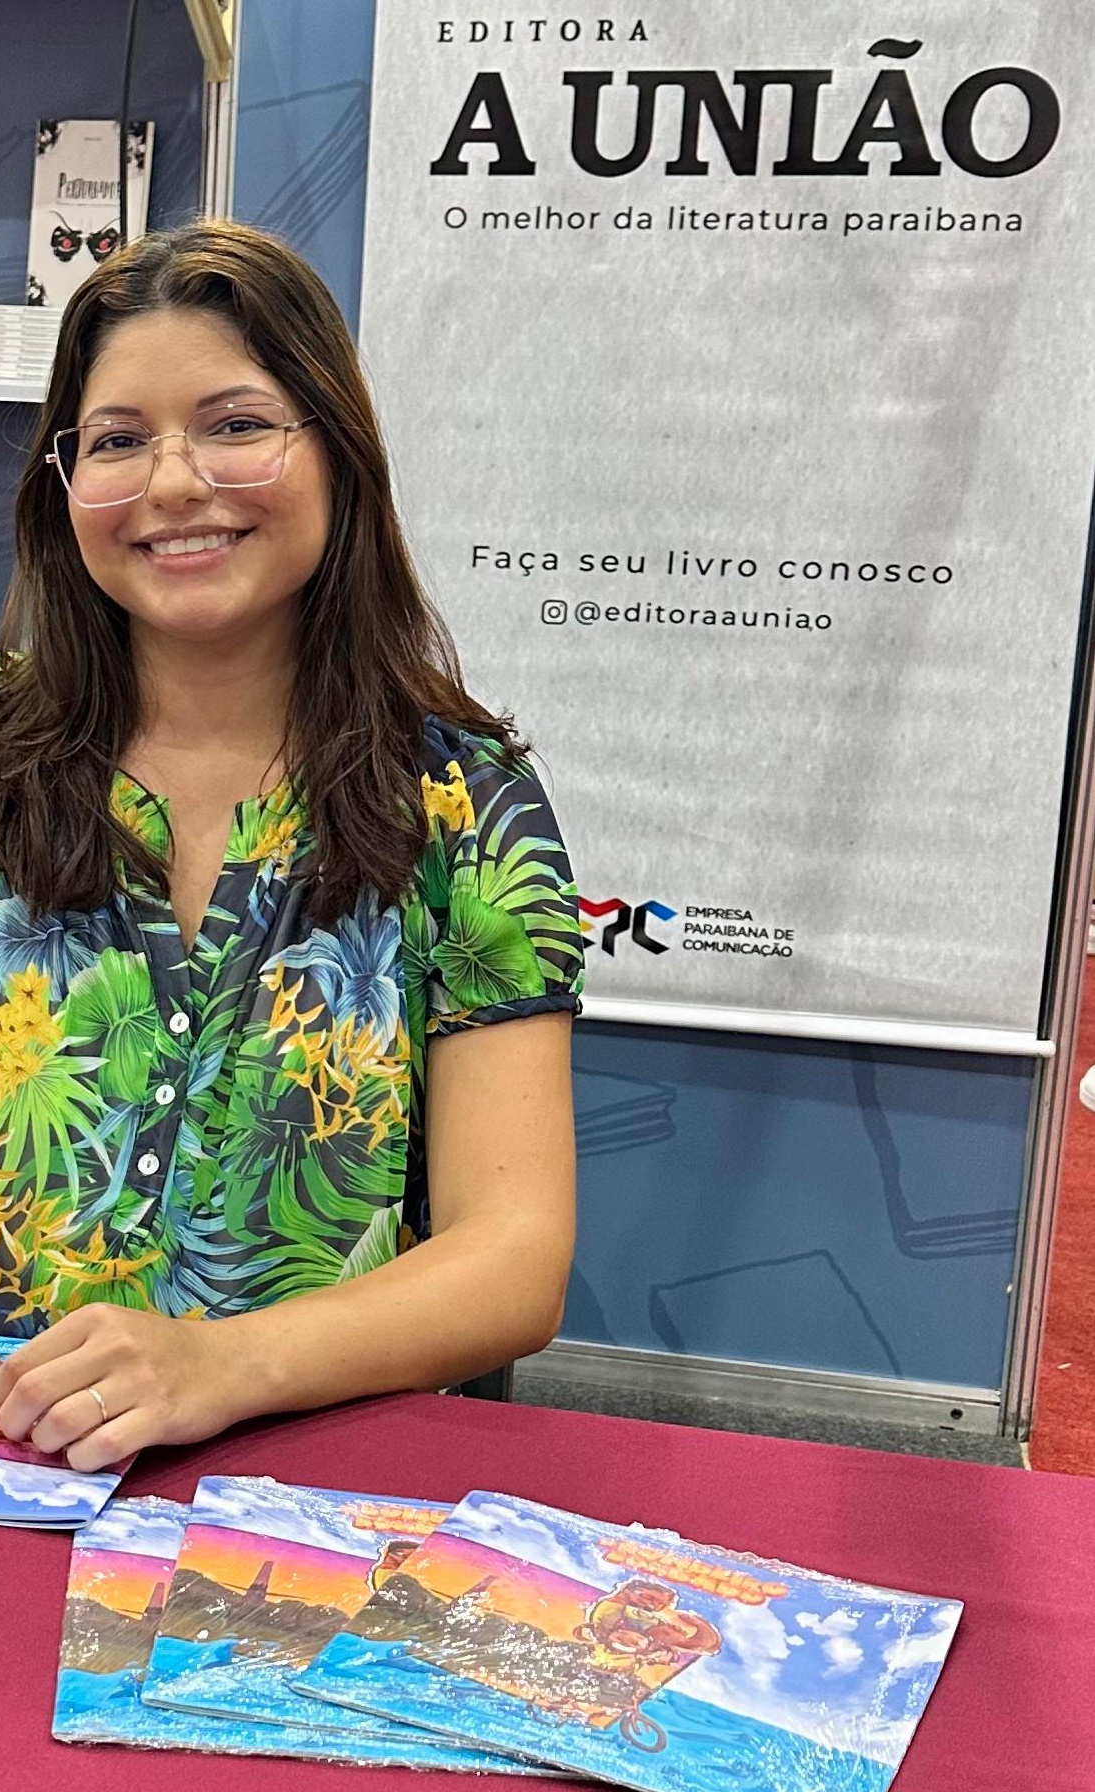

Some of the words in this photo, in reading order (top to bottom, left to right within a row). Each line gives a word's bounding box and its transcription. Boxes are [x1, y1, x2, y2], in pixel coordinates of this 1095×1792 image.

[438, 19, 648, 43] EDITORA
[429, 72, 536, 176] A
[561, 37, 1061, 179] UNIÃO
[444, 206, 467, 229] O
[481, 206, 601, 230] melhor
[613, 206, 652, 230] da
[668, 205, 828, 231] literatura
[843, 206, 1023, 237] paraibana
[471, 545, 559, 577] Faça
[579, 554, 646, 574] seu
[667, 550, 758, 578] livro
[778, 560, 954, 585] conosco
[574, 601, 832, 632] @editoraauniao
[578, 897, 678, 957] PC
[685, 905, 753, 921] EMPRESA
[683, 922, 770, 940] PARAIBANA
[773, 928, 795, 941] DE
[682, 939, 793, 958] COMUNICAÇÃO
